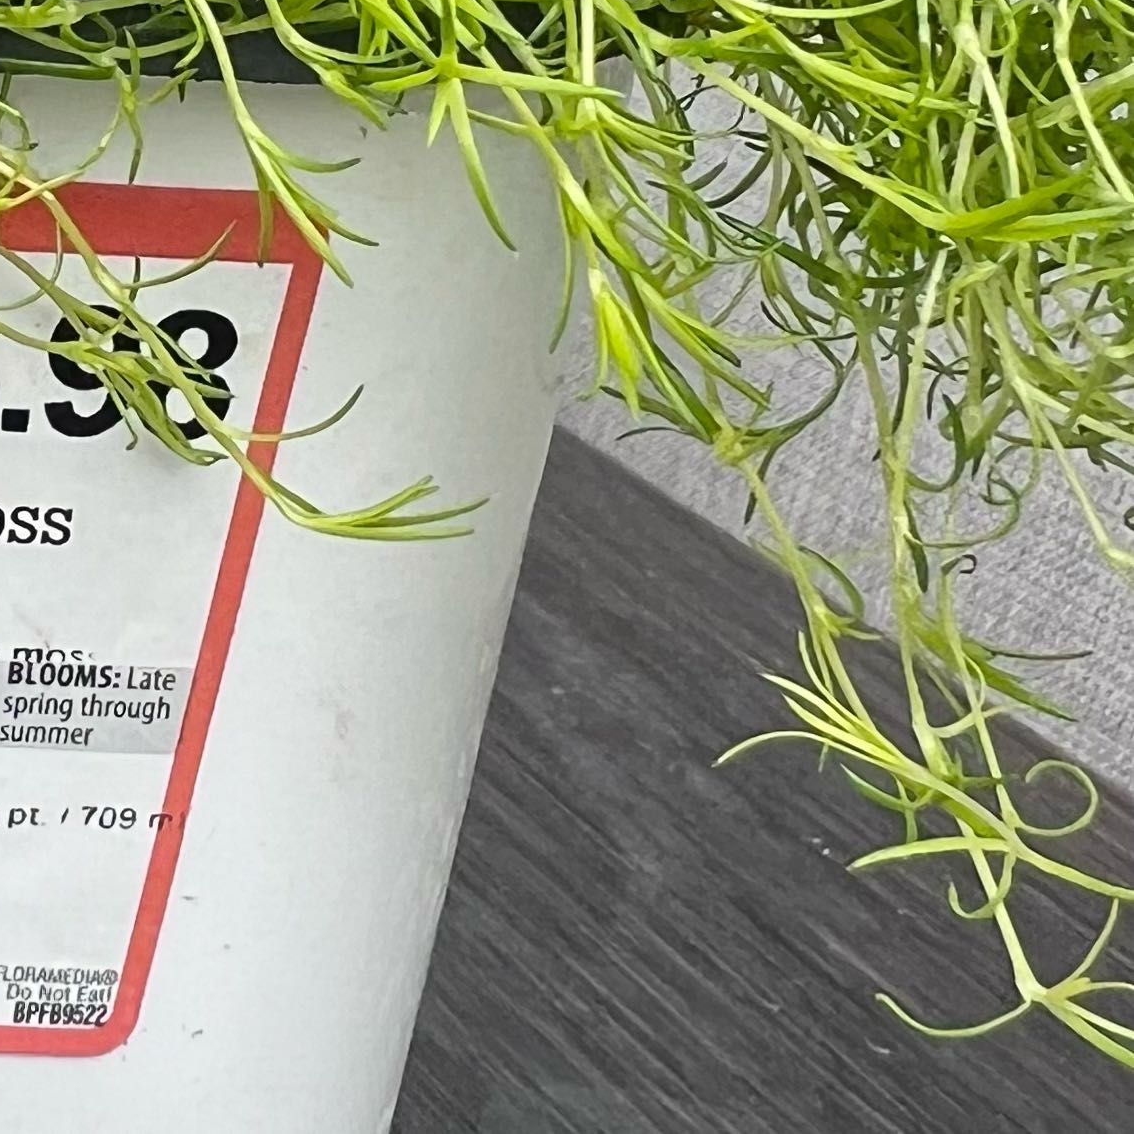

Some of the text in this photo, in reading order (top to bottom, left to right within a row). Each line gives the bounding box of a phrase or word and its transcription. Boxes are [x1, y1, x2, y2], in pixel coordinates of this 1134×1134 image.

[7, 661, 176, 691] BLOOMS: Late
[2, 692, 171, 725] spring through
[0, 724, 94, 746] summer
[81, 806, 137, 829] 709
[6, 982, 32, 1001] Do
[39, 984, 70, 1002] Not
[13, 1000, 109, 1027] BPFB9522
